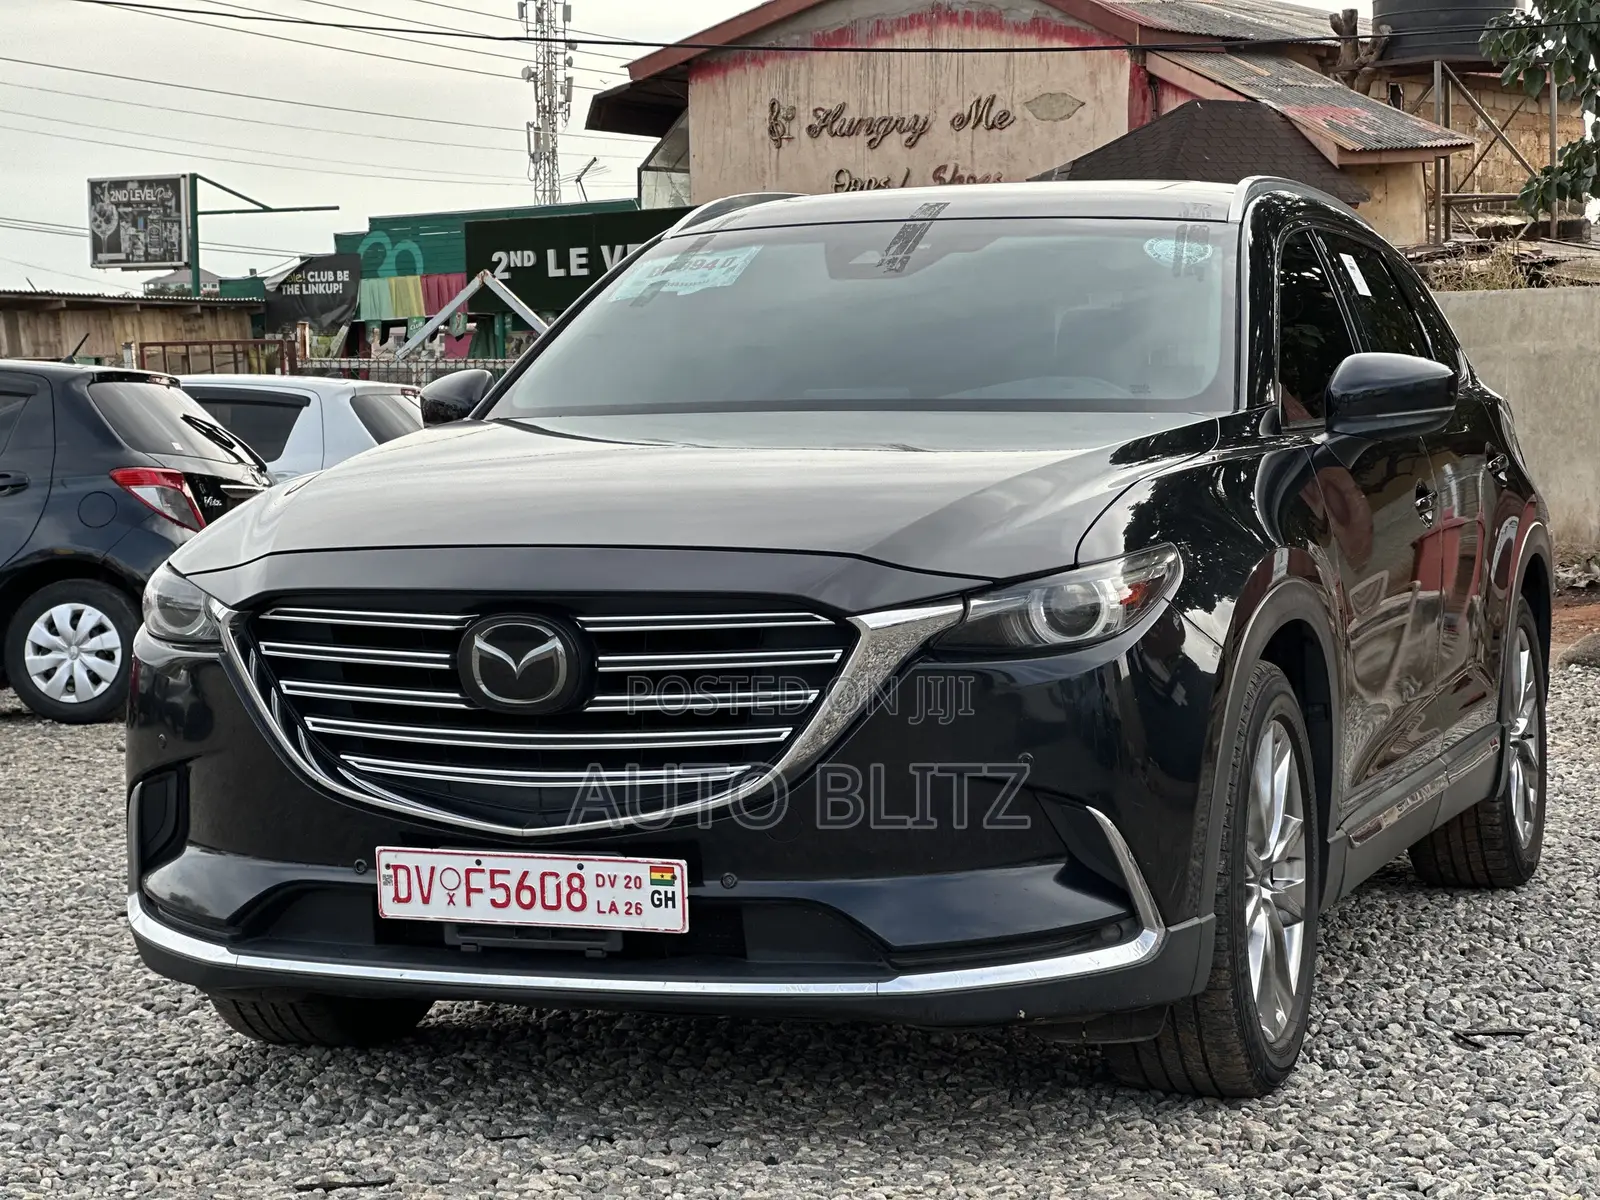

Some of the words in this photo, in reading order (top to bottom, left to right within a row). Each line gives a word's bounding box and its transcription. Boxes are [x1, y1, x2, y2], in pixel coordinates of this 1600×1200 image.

[806, 101, 930, 150] Hungry
[950, 94, 1016, 131] Me
[110, 190, 129, 201] 2ND
[130, 188, 156, 201] LEVEL
[492, 250, 537, 279] 2ND
[307, 271, 334, 282] CLUB
[336, 270, 350, 281] BE
[281, 284, 300, 295] THE
[302, 283, 343, 294] LINKUP!
[391, 864, 436, 905] DV
[465, 867, 588, 912] F5608
[595, 874, 617, 888] DV
[624, 875, 642, 889] 20
[650, 889, 676, 909] GH
[596, 900, 619, 915] LA
[624, 901, 643, 916] 26
